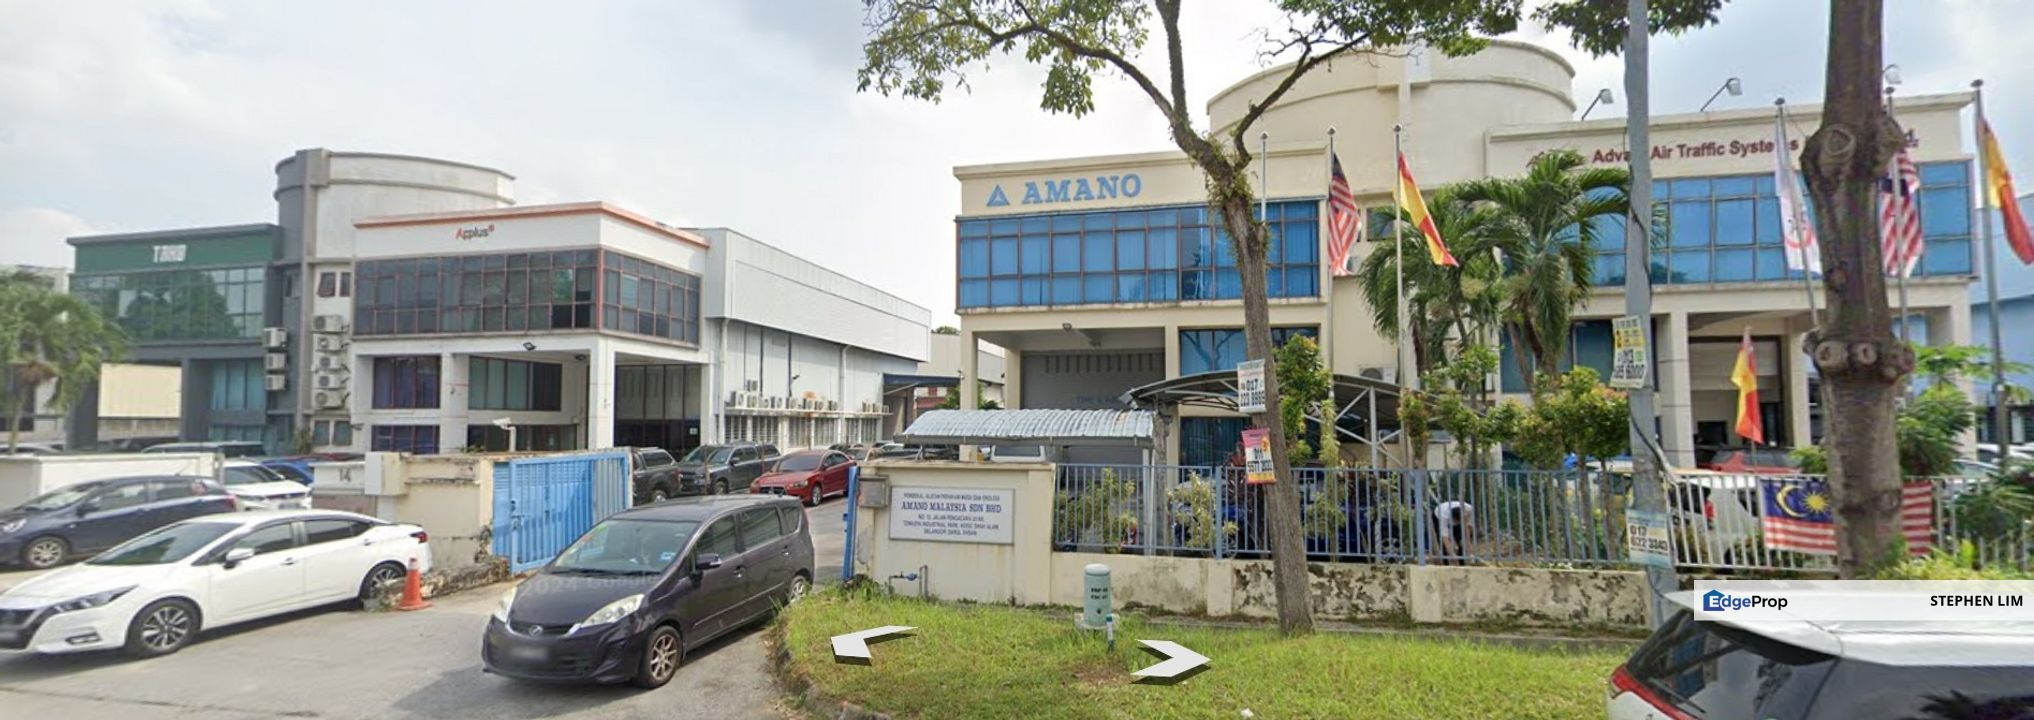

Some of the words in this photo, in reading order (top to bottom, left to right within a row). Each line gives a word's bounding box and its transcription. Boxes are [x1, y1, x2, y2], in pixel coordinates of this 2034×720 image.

[1650, 145, 1673, 159] Air
[1677, 141, 1725, 157] Traffic
[1729, 138, 1799, 157] Systes
[1021, 173, 1142, 205] AMANO
[901, 501, 928, 510] AMANO
[929, 502, 967, 512] MALAYSIA
[969, 503, 984, 512] SDN
[985, 504, 1002, 513] BHD
